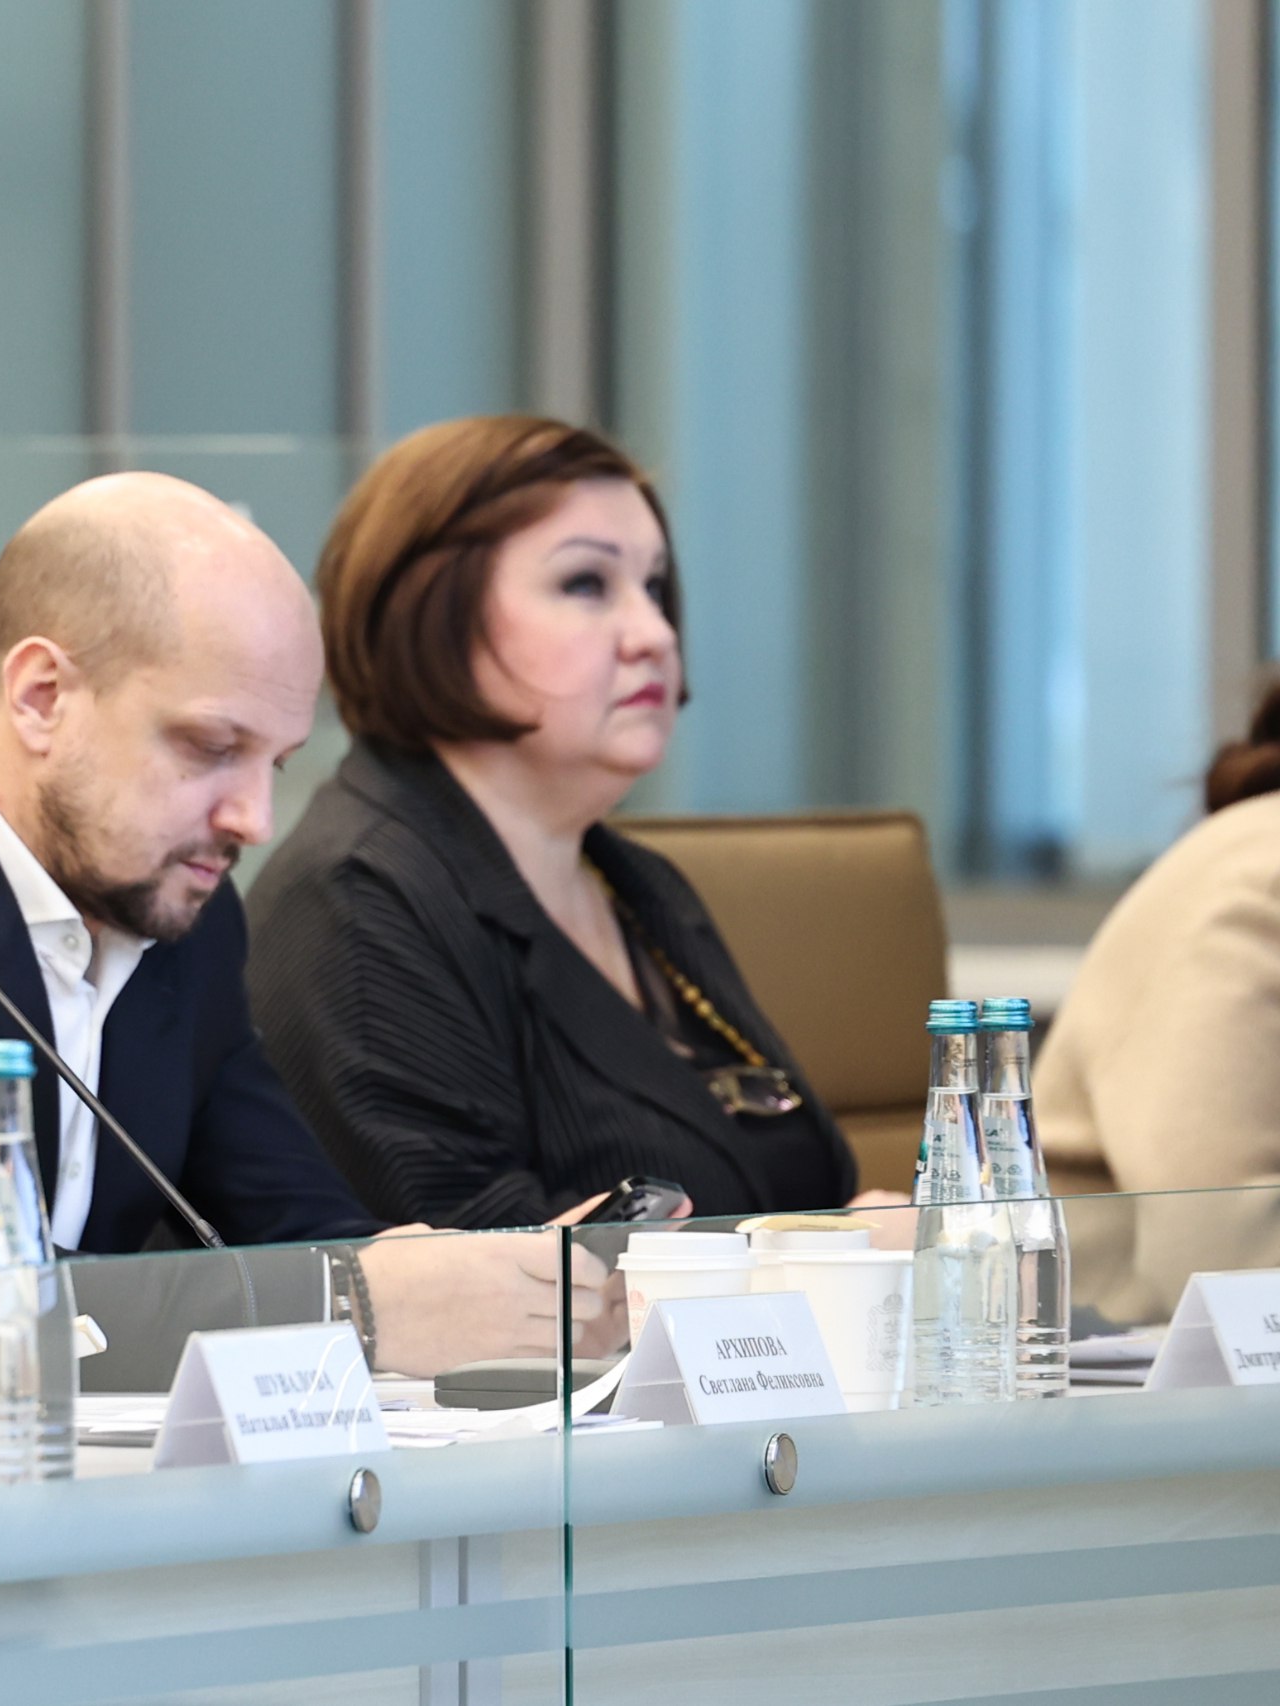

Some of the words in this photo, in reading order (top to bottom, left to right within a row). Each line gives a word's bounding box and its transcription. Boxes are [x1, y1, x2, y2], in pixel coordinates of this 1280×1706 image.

[715, 1335, 788, 1360] АРХИПОВА
[698, 1374, 757, 1396] Светлана
[756, 1370, 825, 1391] Феликсовна
